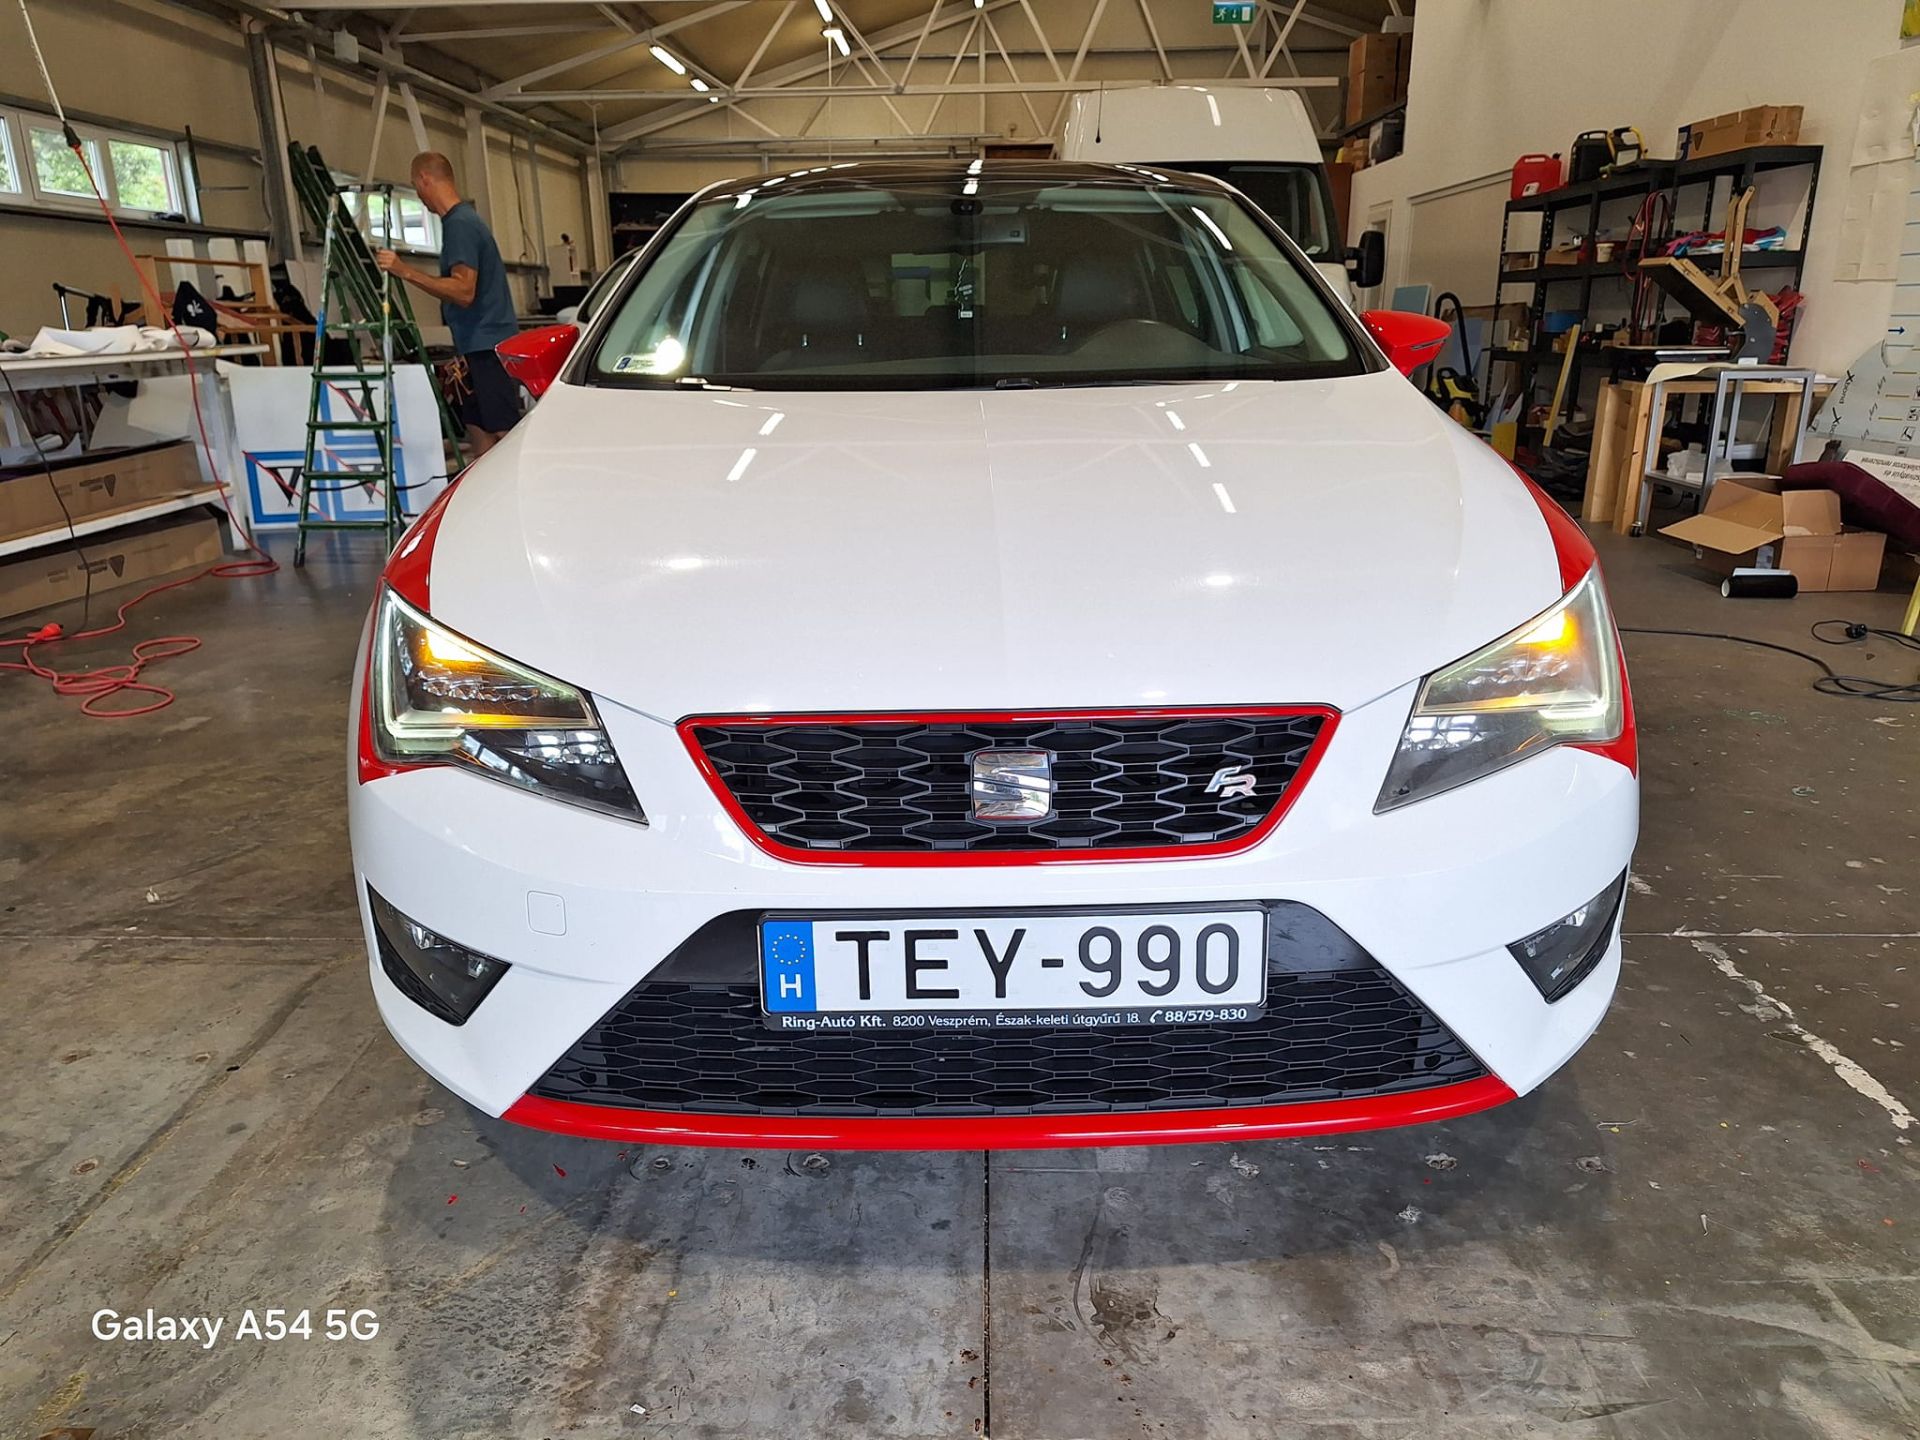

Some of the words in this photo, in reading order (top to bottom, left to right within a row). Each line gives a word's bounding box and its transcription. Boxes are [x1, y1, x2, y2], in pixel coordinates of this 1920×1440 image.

[835, 923, 1240, 1000] TEY-990
[779, 973, 802, 999] H
[782, 1014, 856, 1030] Ring-Autó
[860, 1014, 886, 1028] Kft.
[892, 1014, 925, 1027] 8200
[928, 1013, 992, 1030] Veszprém,
[995, 1012, 1069, 1026] Észak-keleti
[1072, 1012, 1121, 1029] útgyűrű
[1126, 1012, 1141, 1024] 18.
[1164, 1007, 1248, 1023] 88/579-830
